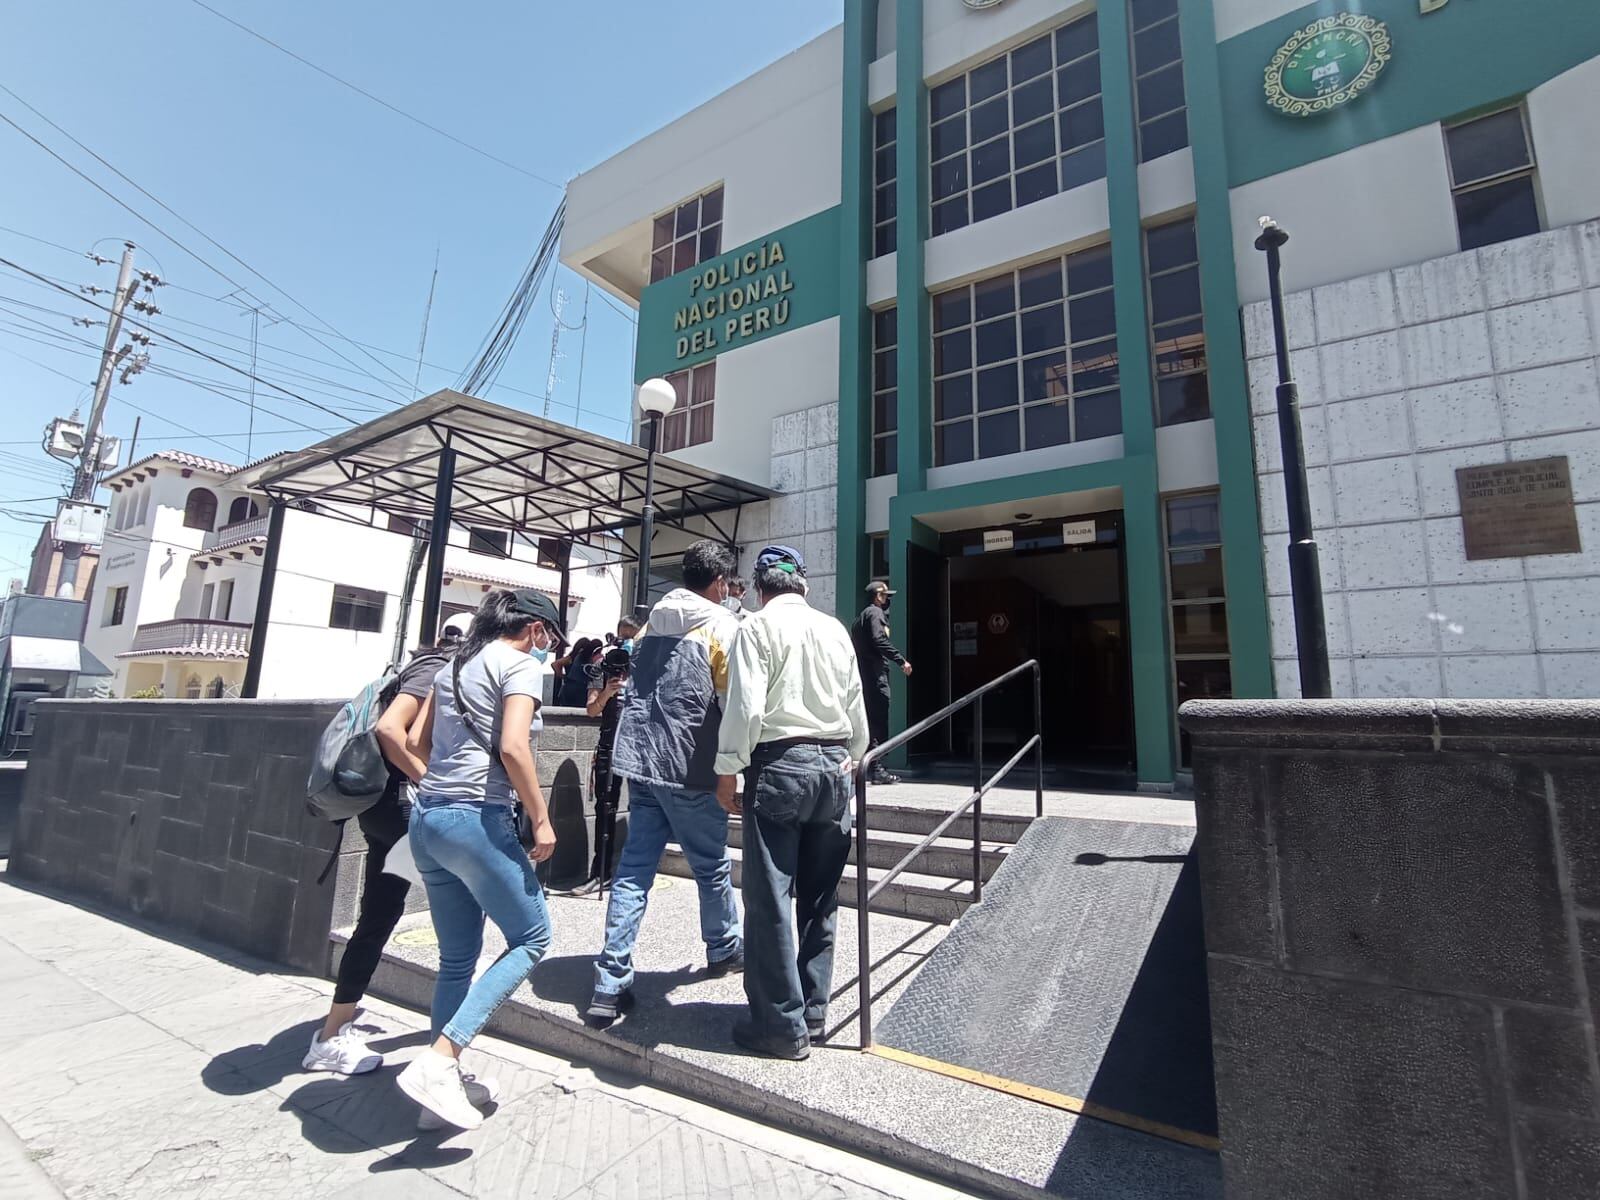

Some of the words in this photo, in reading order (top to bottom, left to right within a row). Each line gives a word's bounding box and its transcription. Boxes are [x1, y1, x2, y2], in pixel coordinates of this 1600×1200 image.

[689, 240, 785, 297] POLICÍA
[674, 269, 794, 331] NACIONAL
[676, 327, 717, 359] DEL
[725, 296, 790, 342] PERÚ
[984, 535, 1012, 544] INGRESO
[1066, 528, 1092, 536] SALIDA
